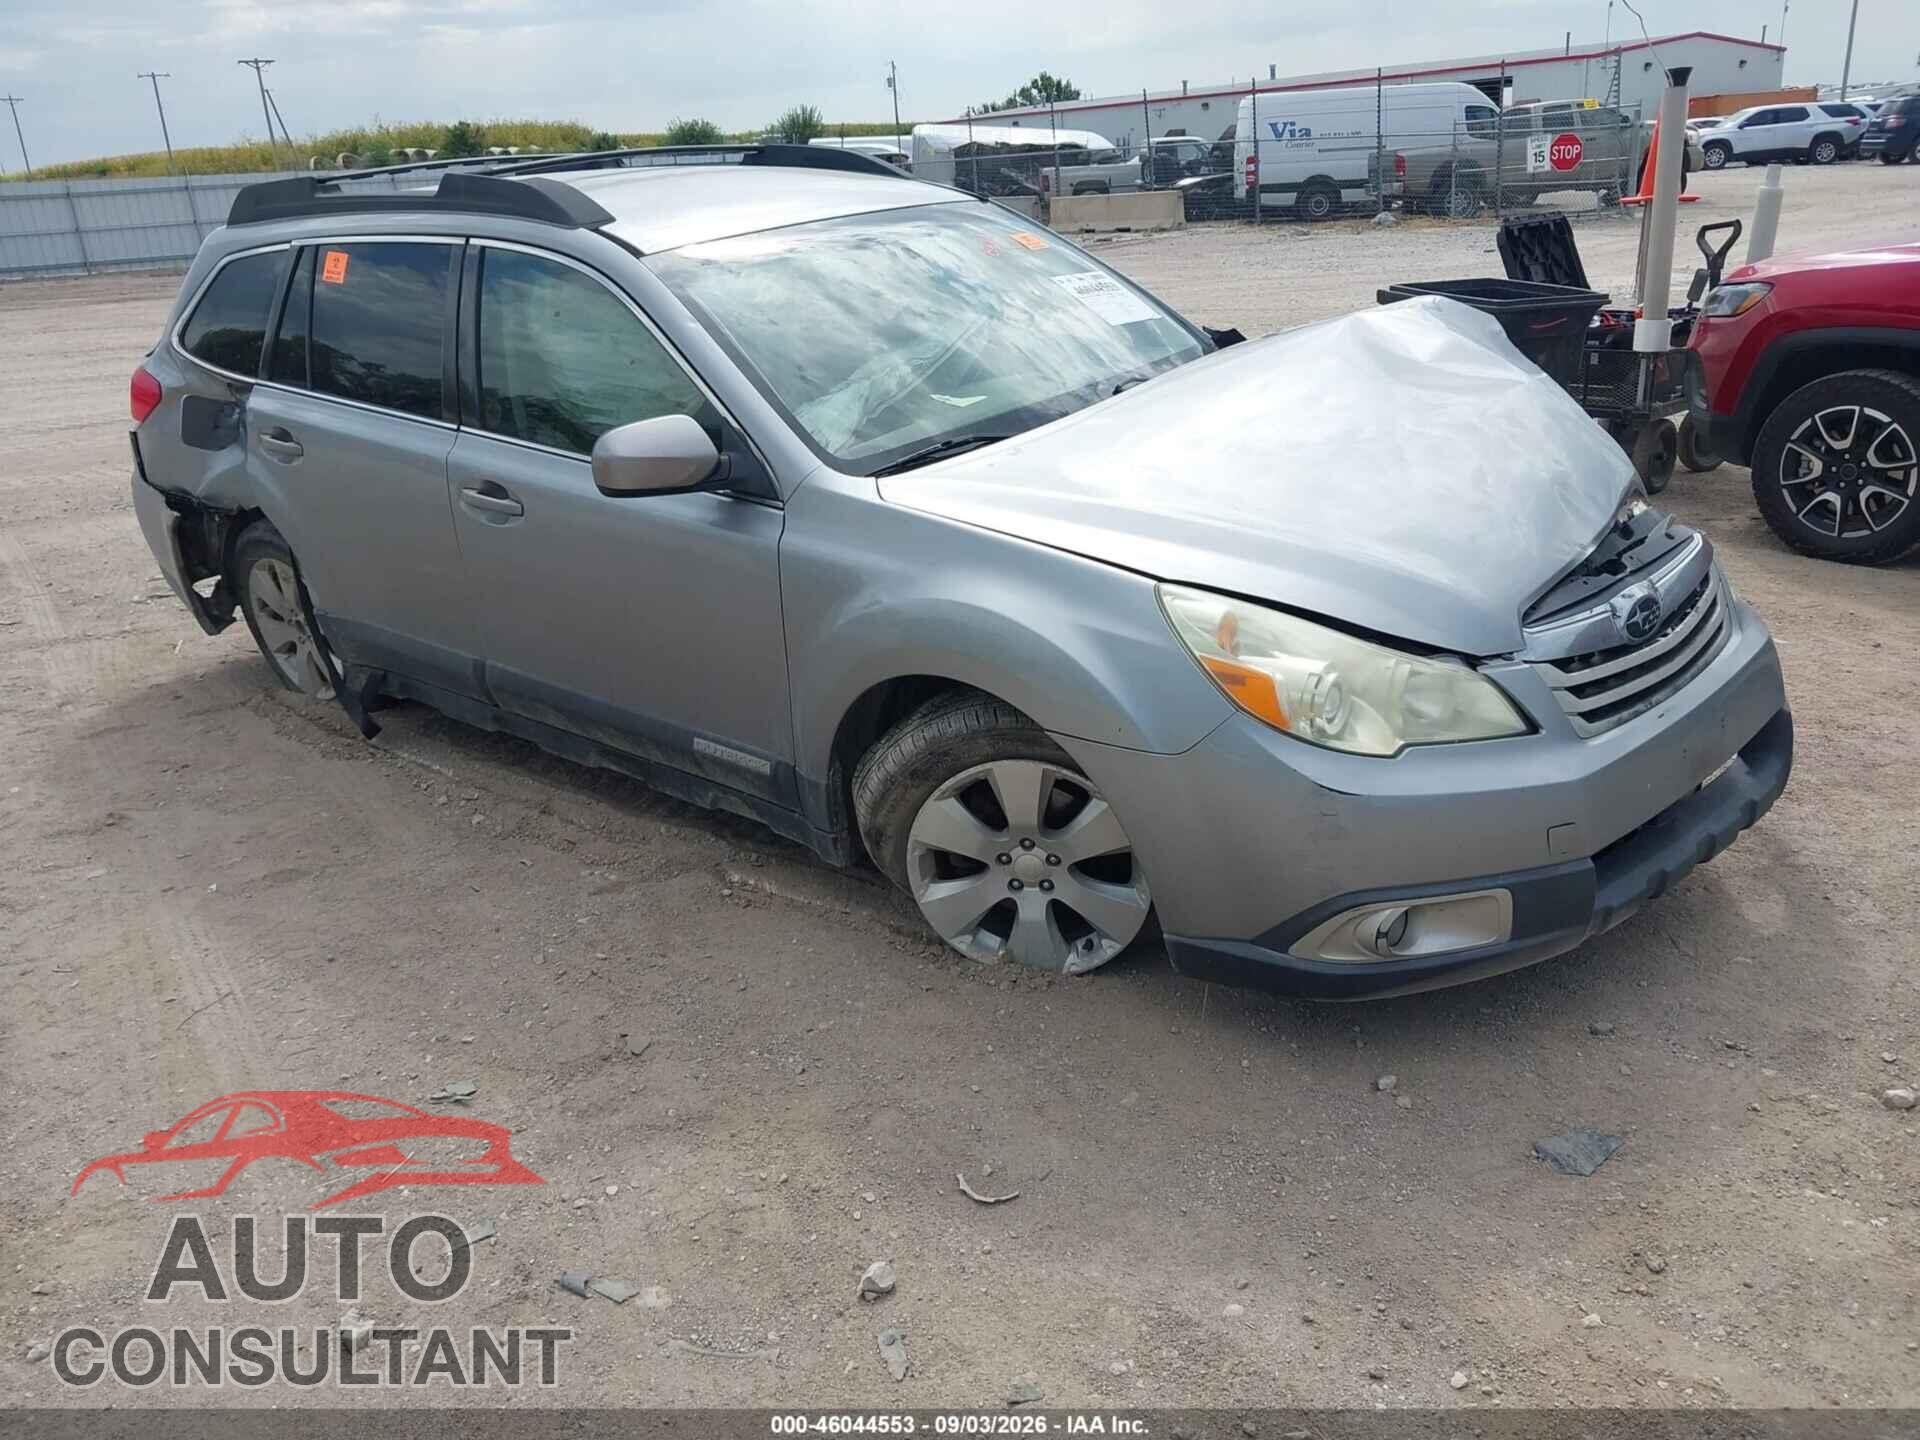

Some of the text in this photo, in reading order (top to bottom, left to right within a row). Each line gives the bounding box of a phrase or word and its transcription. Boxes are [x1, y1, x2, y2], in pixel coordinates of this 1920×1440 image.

[1268, 121, 1312, 141] Via
[1533, 150, 1545, 163] 15
[1551, 145, 1580, 159] STOP
